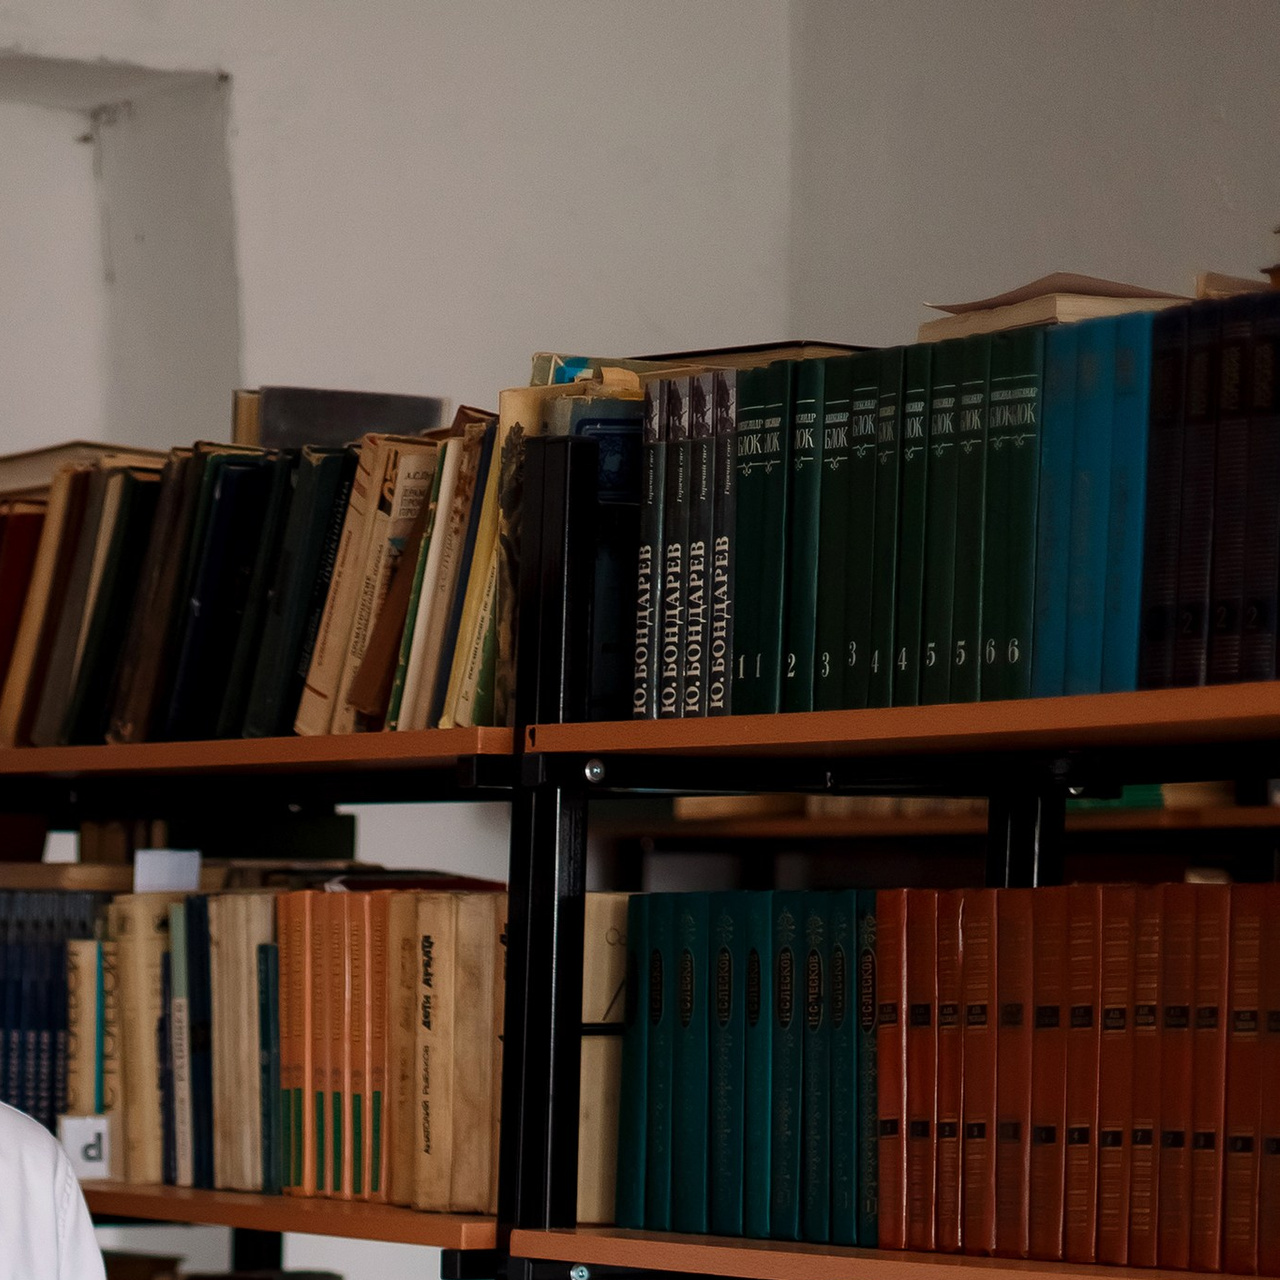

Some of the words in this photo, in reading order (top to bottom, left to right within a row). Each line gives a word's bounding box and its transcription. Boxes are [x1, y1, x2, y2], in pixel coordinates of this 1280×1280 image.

[737, 433, 762, 457] БЛОК
[824, 426, 849, 449] БЛОК
[848, 640, 857, 667] 3
[870, 649, 880, 674] 4
[896, 647, 908, 671] 4
[925, 642, 937, 667] 5
[954, 640, 966, 666] 5
[984, 638, 996, 665] 6
[1006, 637, 1020, 664] 6
[737, 653, 746, 679] 1
[754, 652, 762, 678] 1
[787, 653, 796, 678] 2
[821, 651, 830, 678] 3
